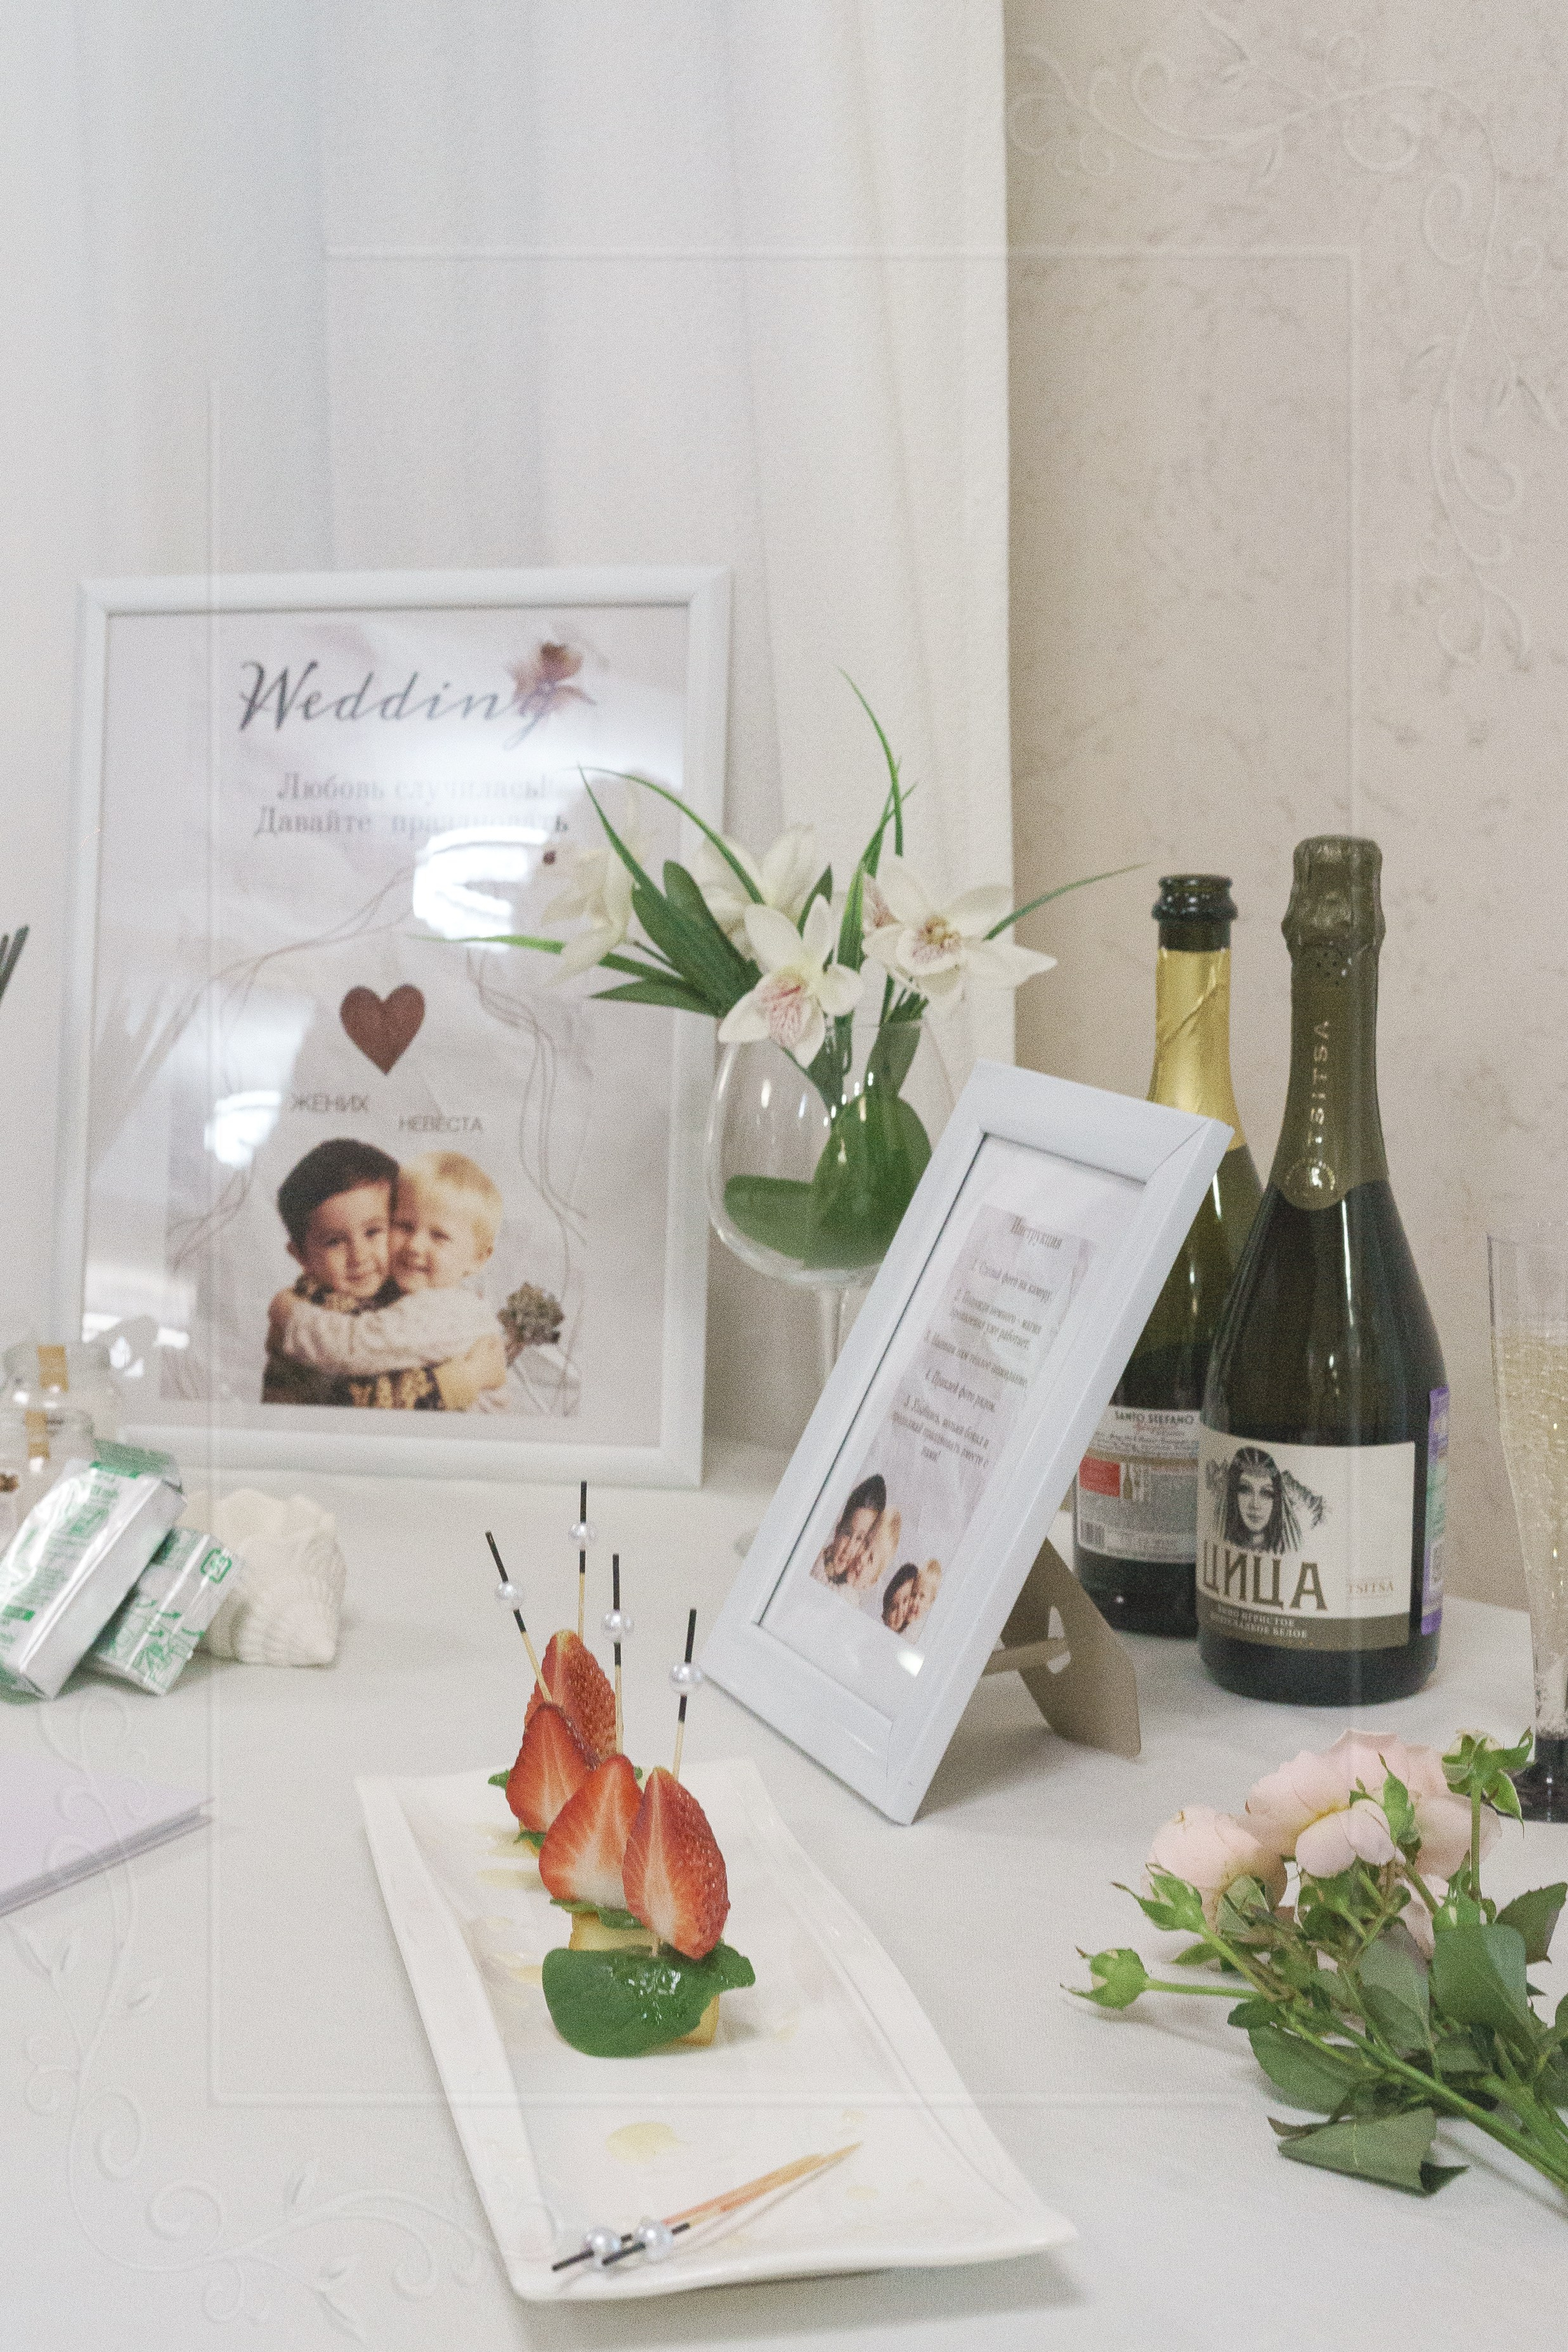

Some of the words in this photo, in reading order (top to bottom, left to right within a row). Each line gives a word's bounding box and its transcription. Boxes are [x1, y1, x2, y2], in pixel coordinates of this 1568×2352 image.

[239, 660, 561, 749] Wedding
[277, 772, 386, 800] Любовь
[253, 805, 373, 837] Давайте
[290, 1092, 369, 1113] ЖЕНИХ
[398, 1114, 484, 1134] НЕВЕСТА
[1115, 1411, 1145, 1423] SANTO
[1149, 1414, 1194, 1425] STEFANO
